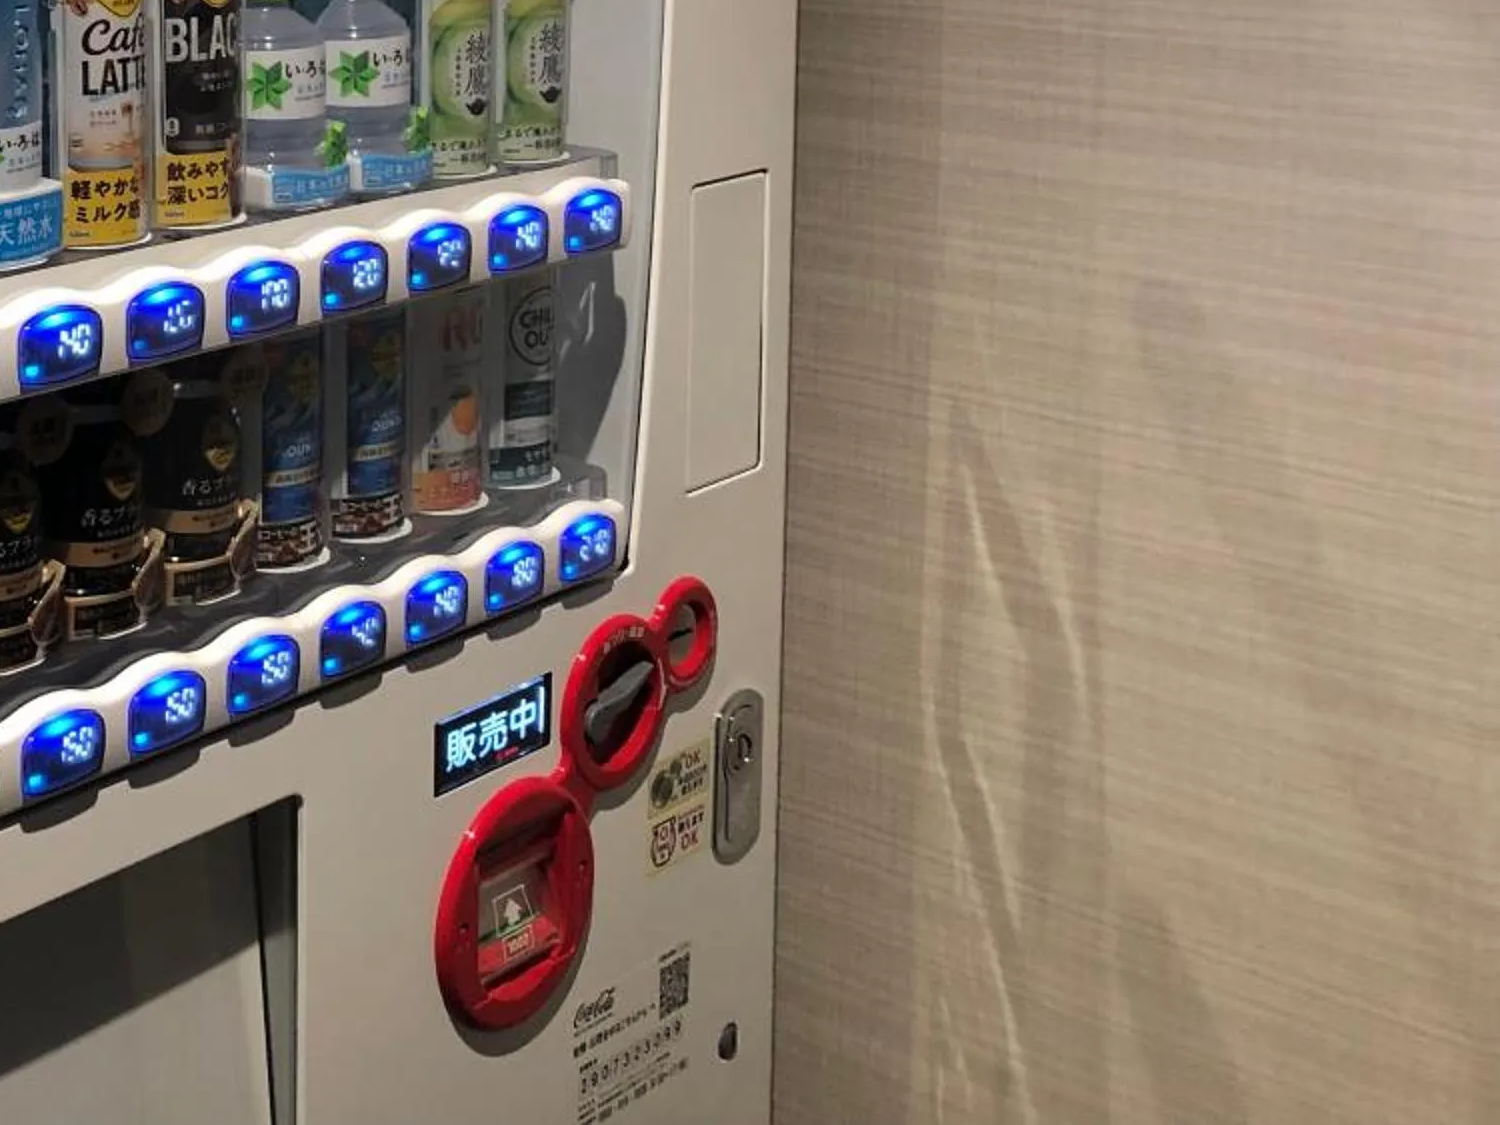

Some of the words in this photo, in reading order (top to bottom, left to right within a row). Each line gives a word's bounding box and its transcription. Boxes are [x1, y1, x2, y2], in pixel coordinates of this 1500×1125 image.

[57, 323, 91, 359] 140
[261, 651, 291, 686] 150
[165, 687, 195, 723] 150
[61, 726, 94, 764] 150
[445, 696, 538, 773] 販売中
